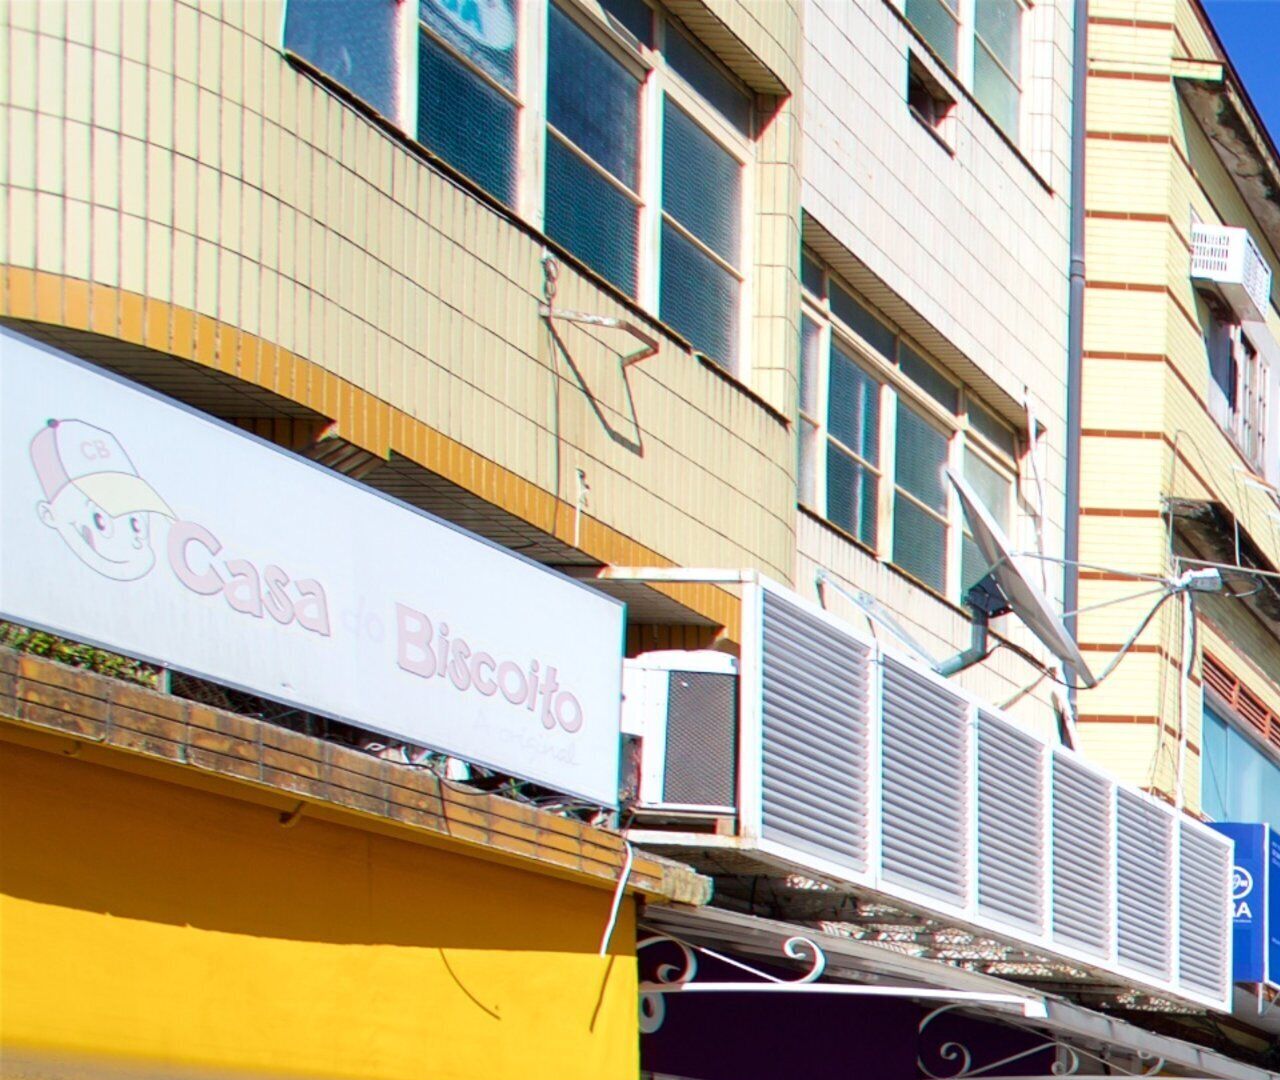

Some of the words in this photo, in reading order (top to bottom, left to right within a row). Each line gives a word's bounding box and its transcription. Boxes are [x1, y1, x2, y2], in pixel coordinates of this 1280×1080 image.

[80, 439, 111, 461] CB
[167, 520, 331, 637] Casa
[394, 601, 584, 735] Biscoito
